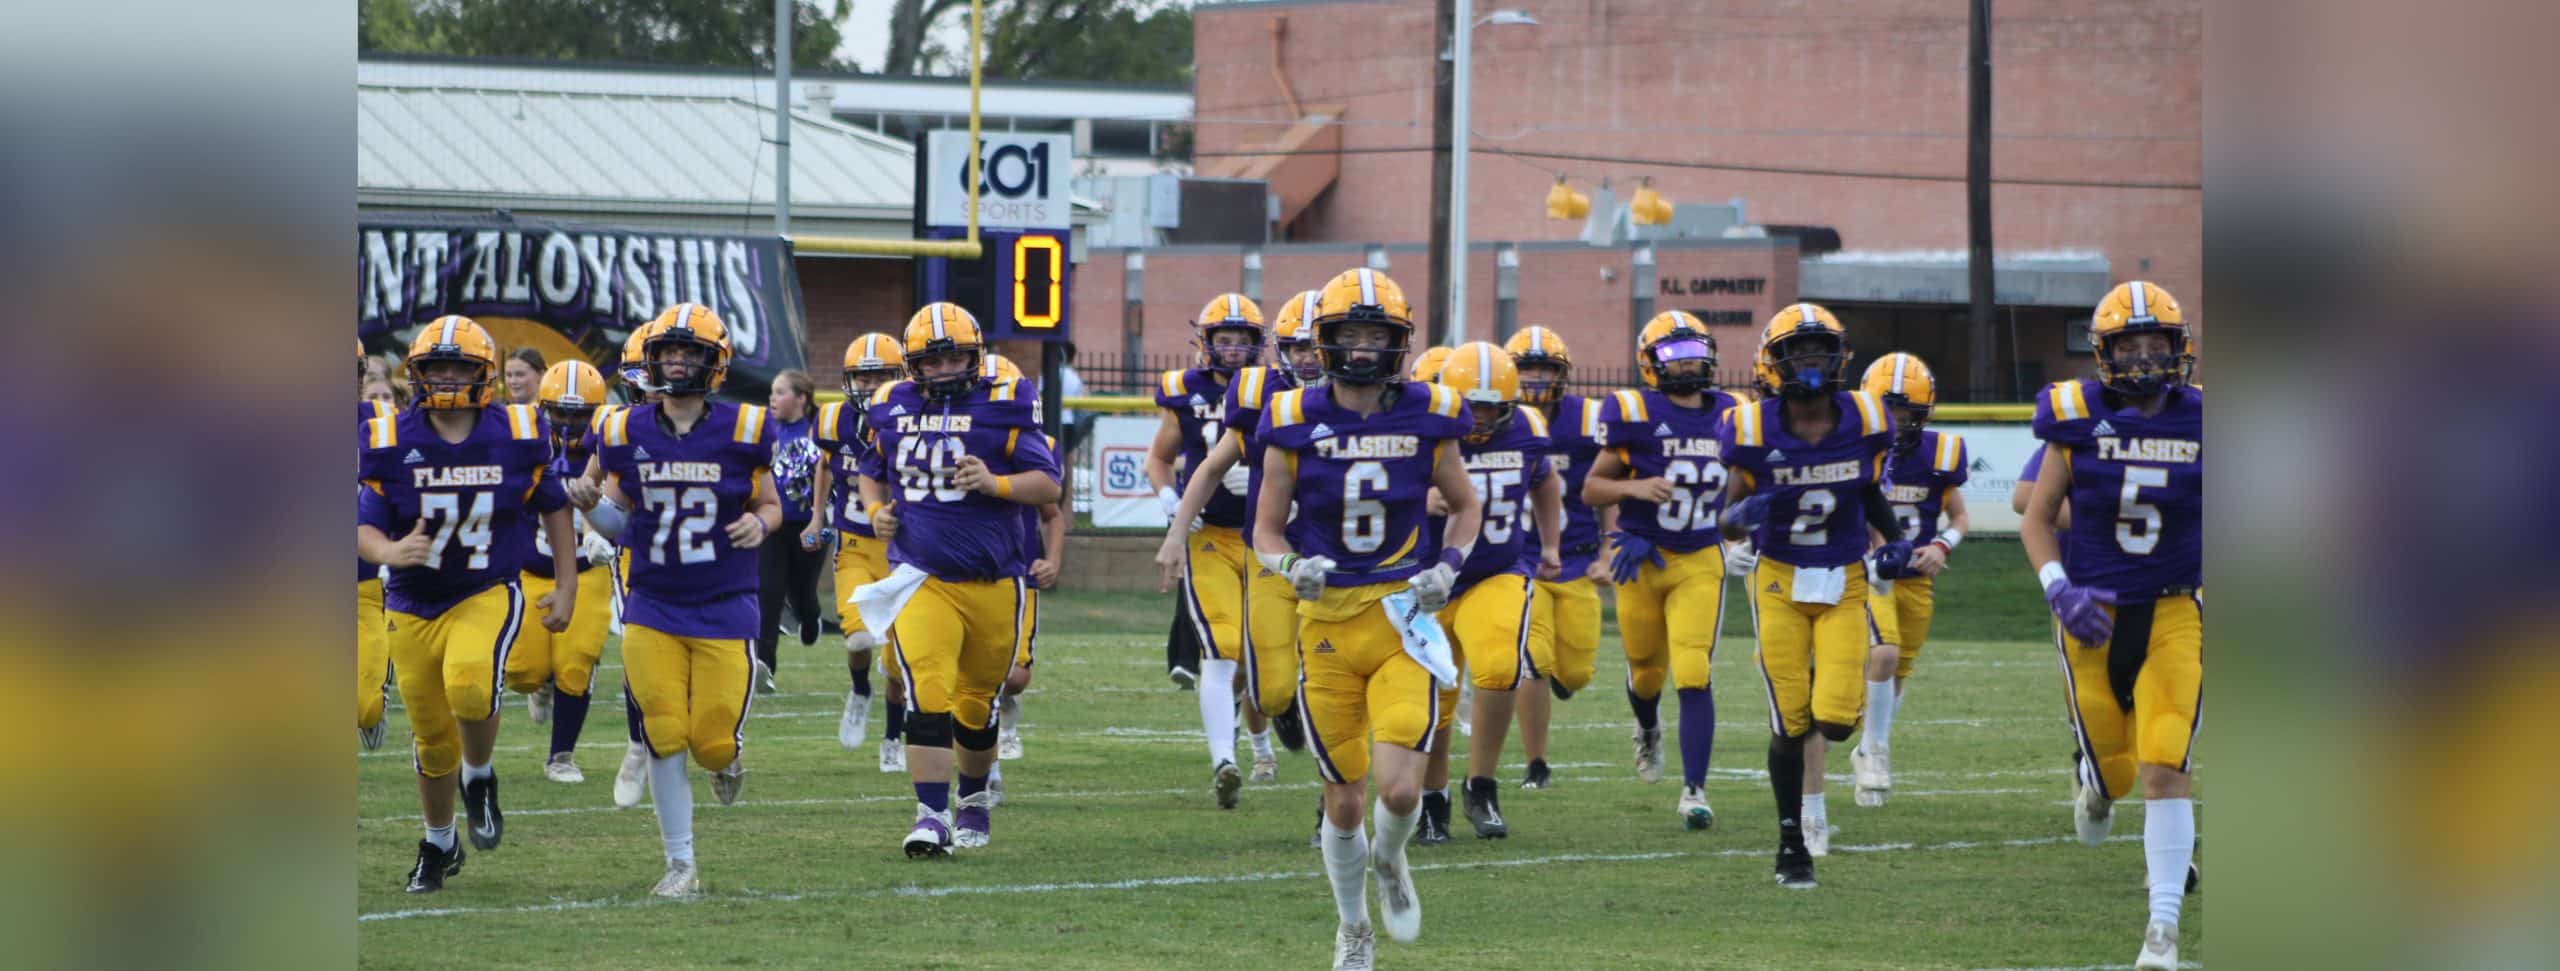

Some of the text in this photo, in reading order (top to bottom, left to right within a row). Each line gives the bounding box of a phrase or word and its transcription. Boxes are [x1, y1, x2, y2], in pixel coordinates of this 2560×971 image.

[463, 231, 758, 356] ALOYSIUS
[1014, 235, 1061, 327] 0
[637, 461, 721, 483] FLASHES
[1314, 435, 1419, 460] FLASHES
[1461, 451, 1523, 470] LASHES
[1662, 438, 1722, 458] FLASH
[1772, 459, 1861, 486] FLASHES
[2097, 437, 2200, 464] FLASHES
[413, 465, 504, 488] FLASHES
[1656, 459, 1729, 532] 62
[420, 491, 495, 570] 74
[641, 486, 718, 566] 72
[1342, 461, 1389, 553] 6
[1790, 489, 1836, 545] 2
[2115, 465, 2168, 555] 5
